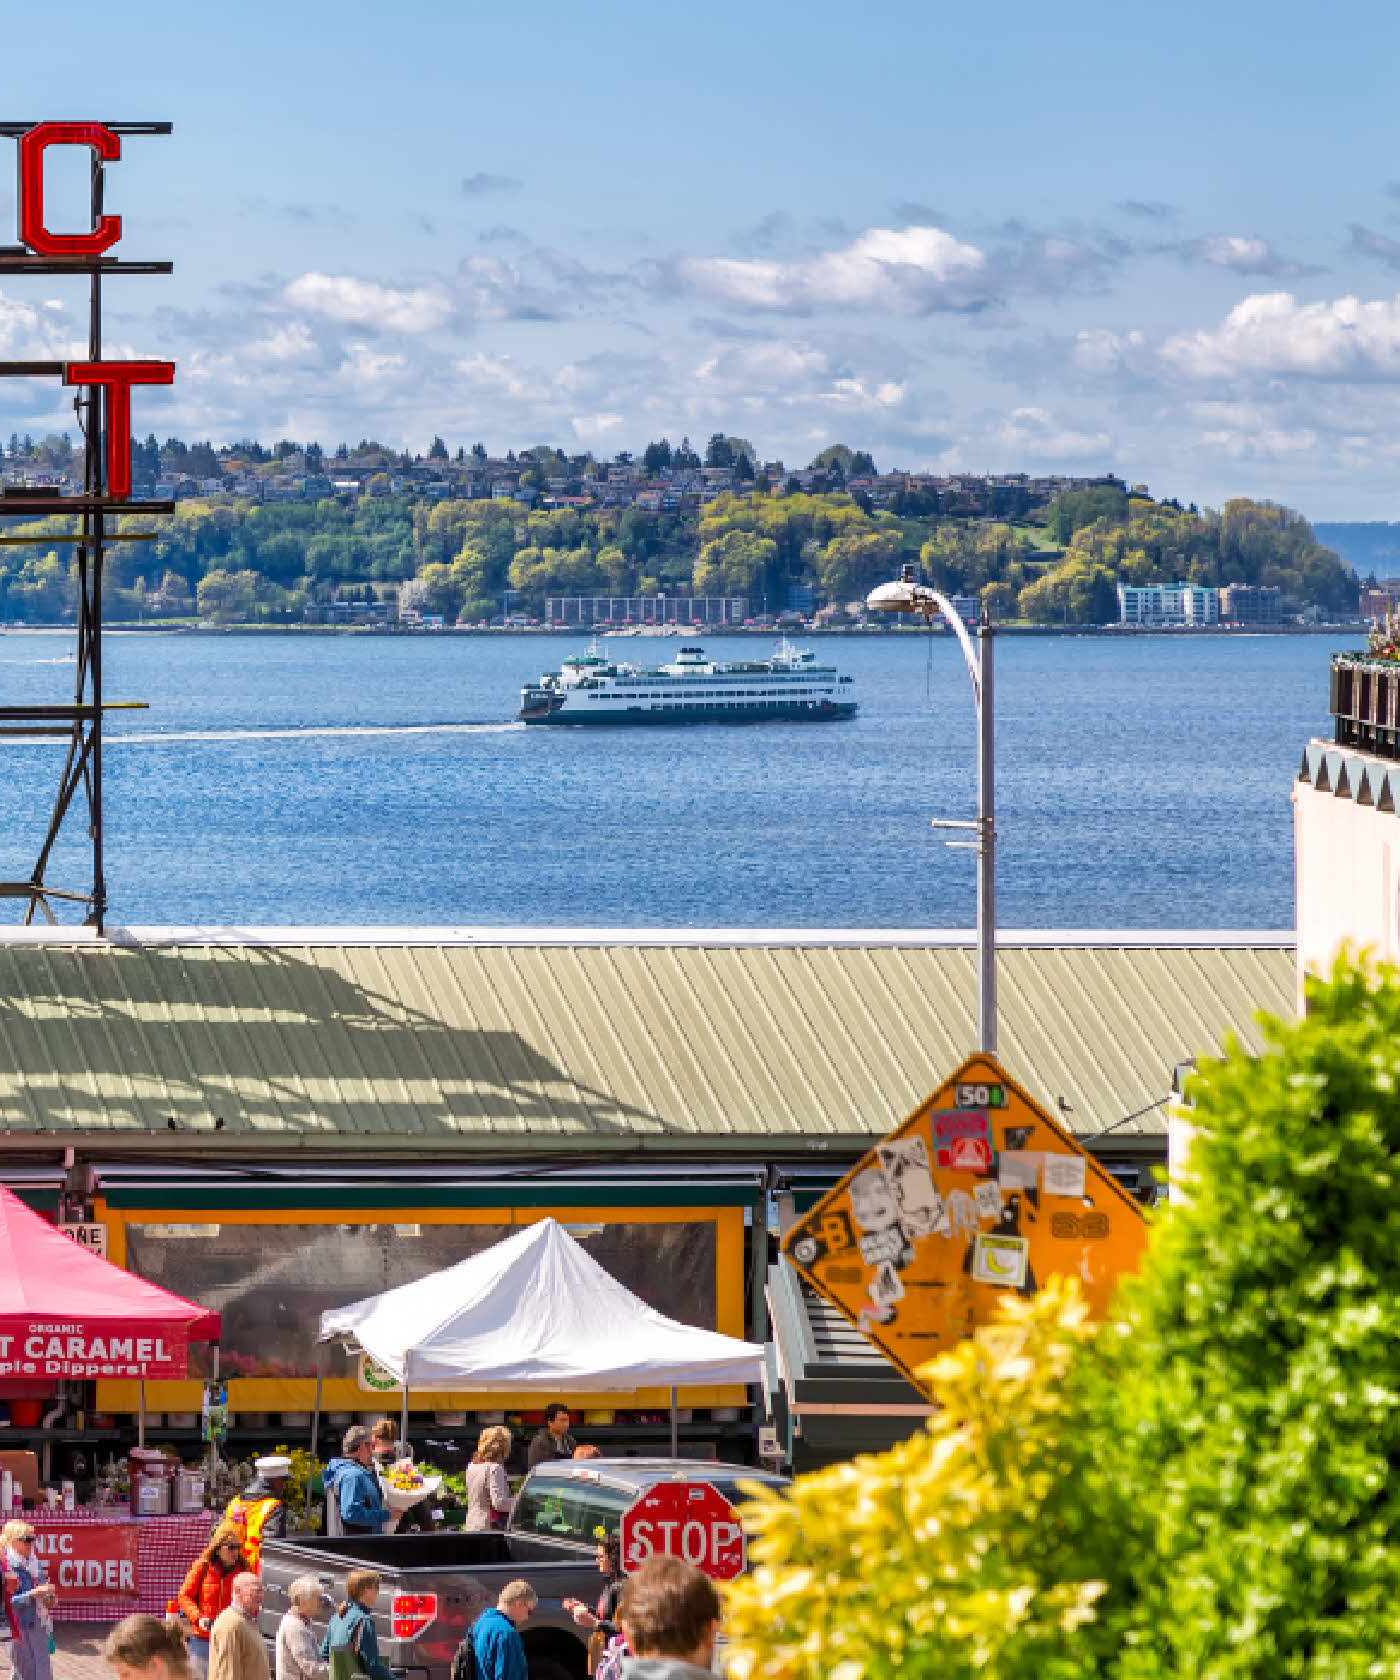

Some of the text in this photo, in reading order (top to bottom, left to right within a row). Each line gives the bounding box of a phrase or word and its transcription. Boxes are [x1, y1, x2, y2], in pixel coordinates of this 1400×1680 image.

[28, 1324, 84, 1335] ORGANIC
[24, 1336, 172, 1362] CARAMEL
[45, 1360, 147, 1376] Dippers!
[631, 1520, 740, 1566] STOP
[59, 1559, 135, 1590] CIDER
